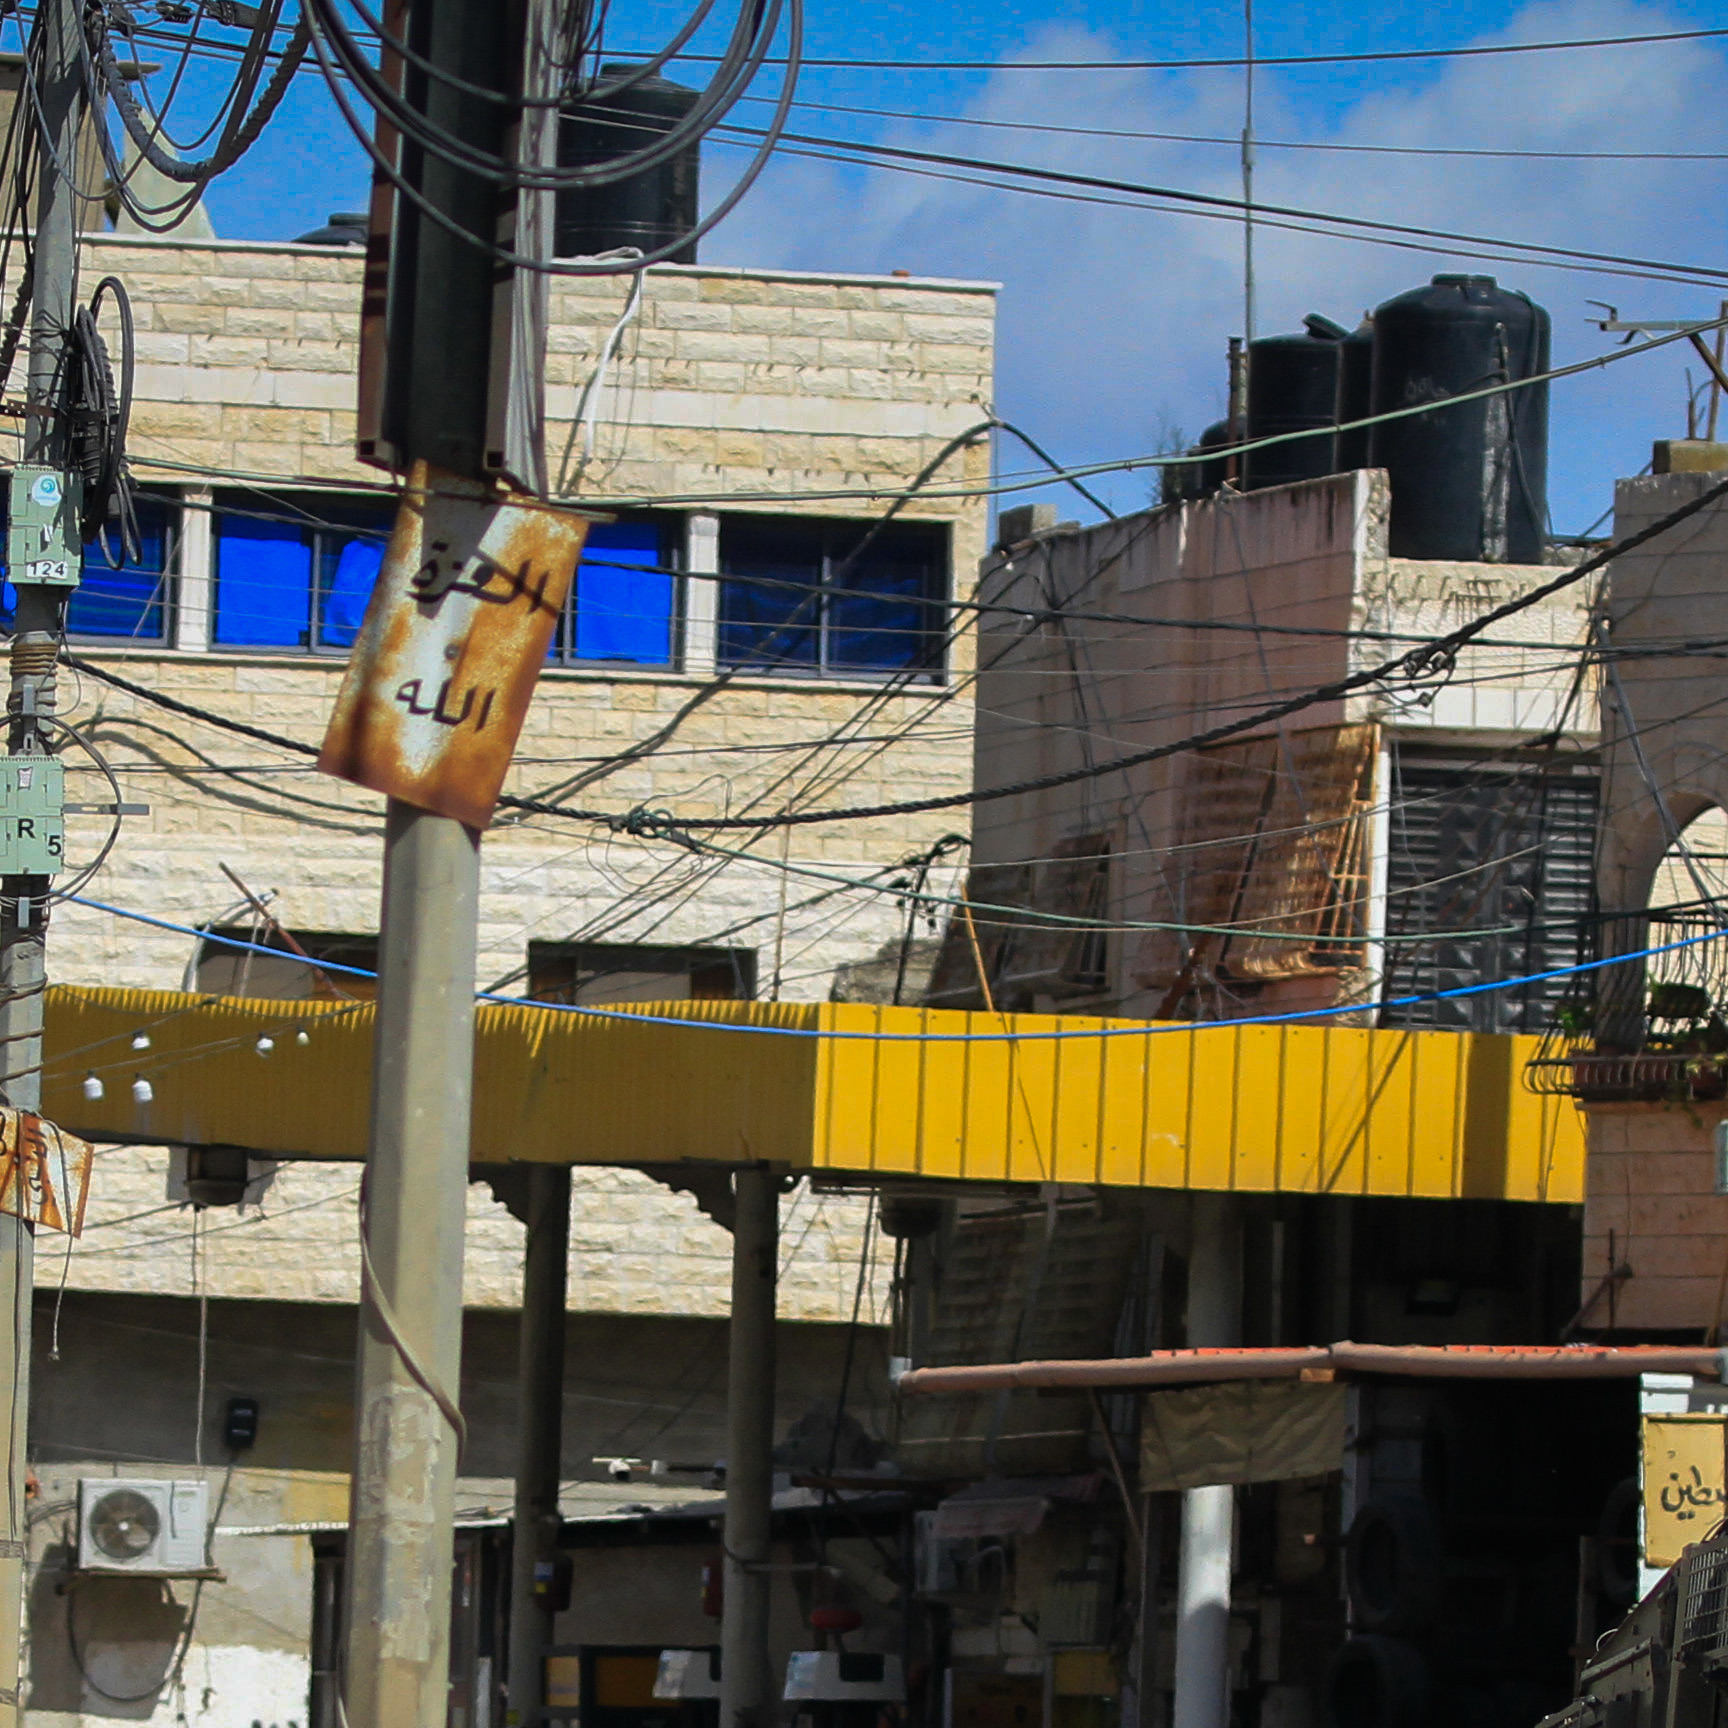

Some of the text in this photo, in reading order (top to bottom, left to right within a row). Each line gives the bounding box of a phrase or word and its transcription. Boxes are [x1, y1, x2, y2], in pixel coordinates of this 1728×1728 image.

[30, 562, 65, 577] 124
[18, 818, 36, 839] R
[48, 834, 62, 856] 5
